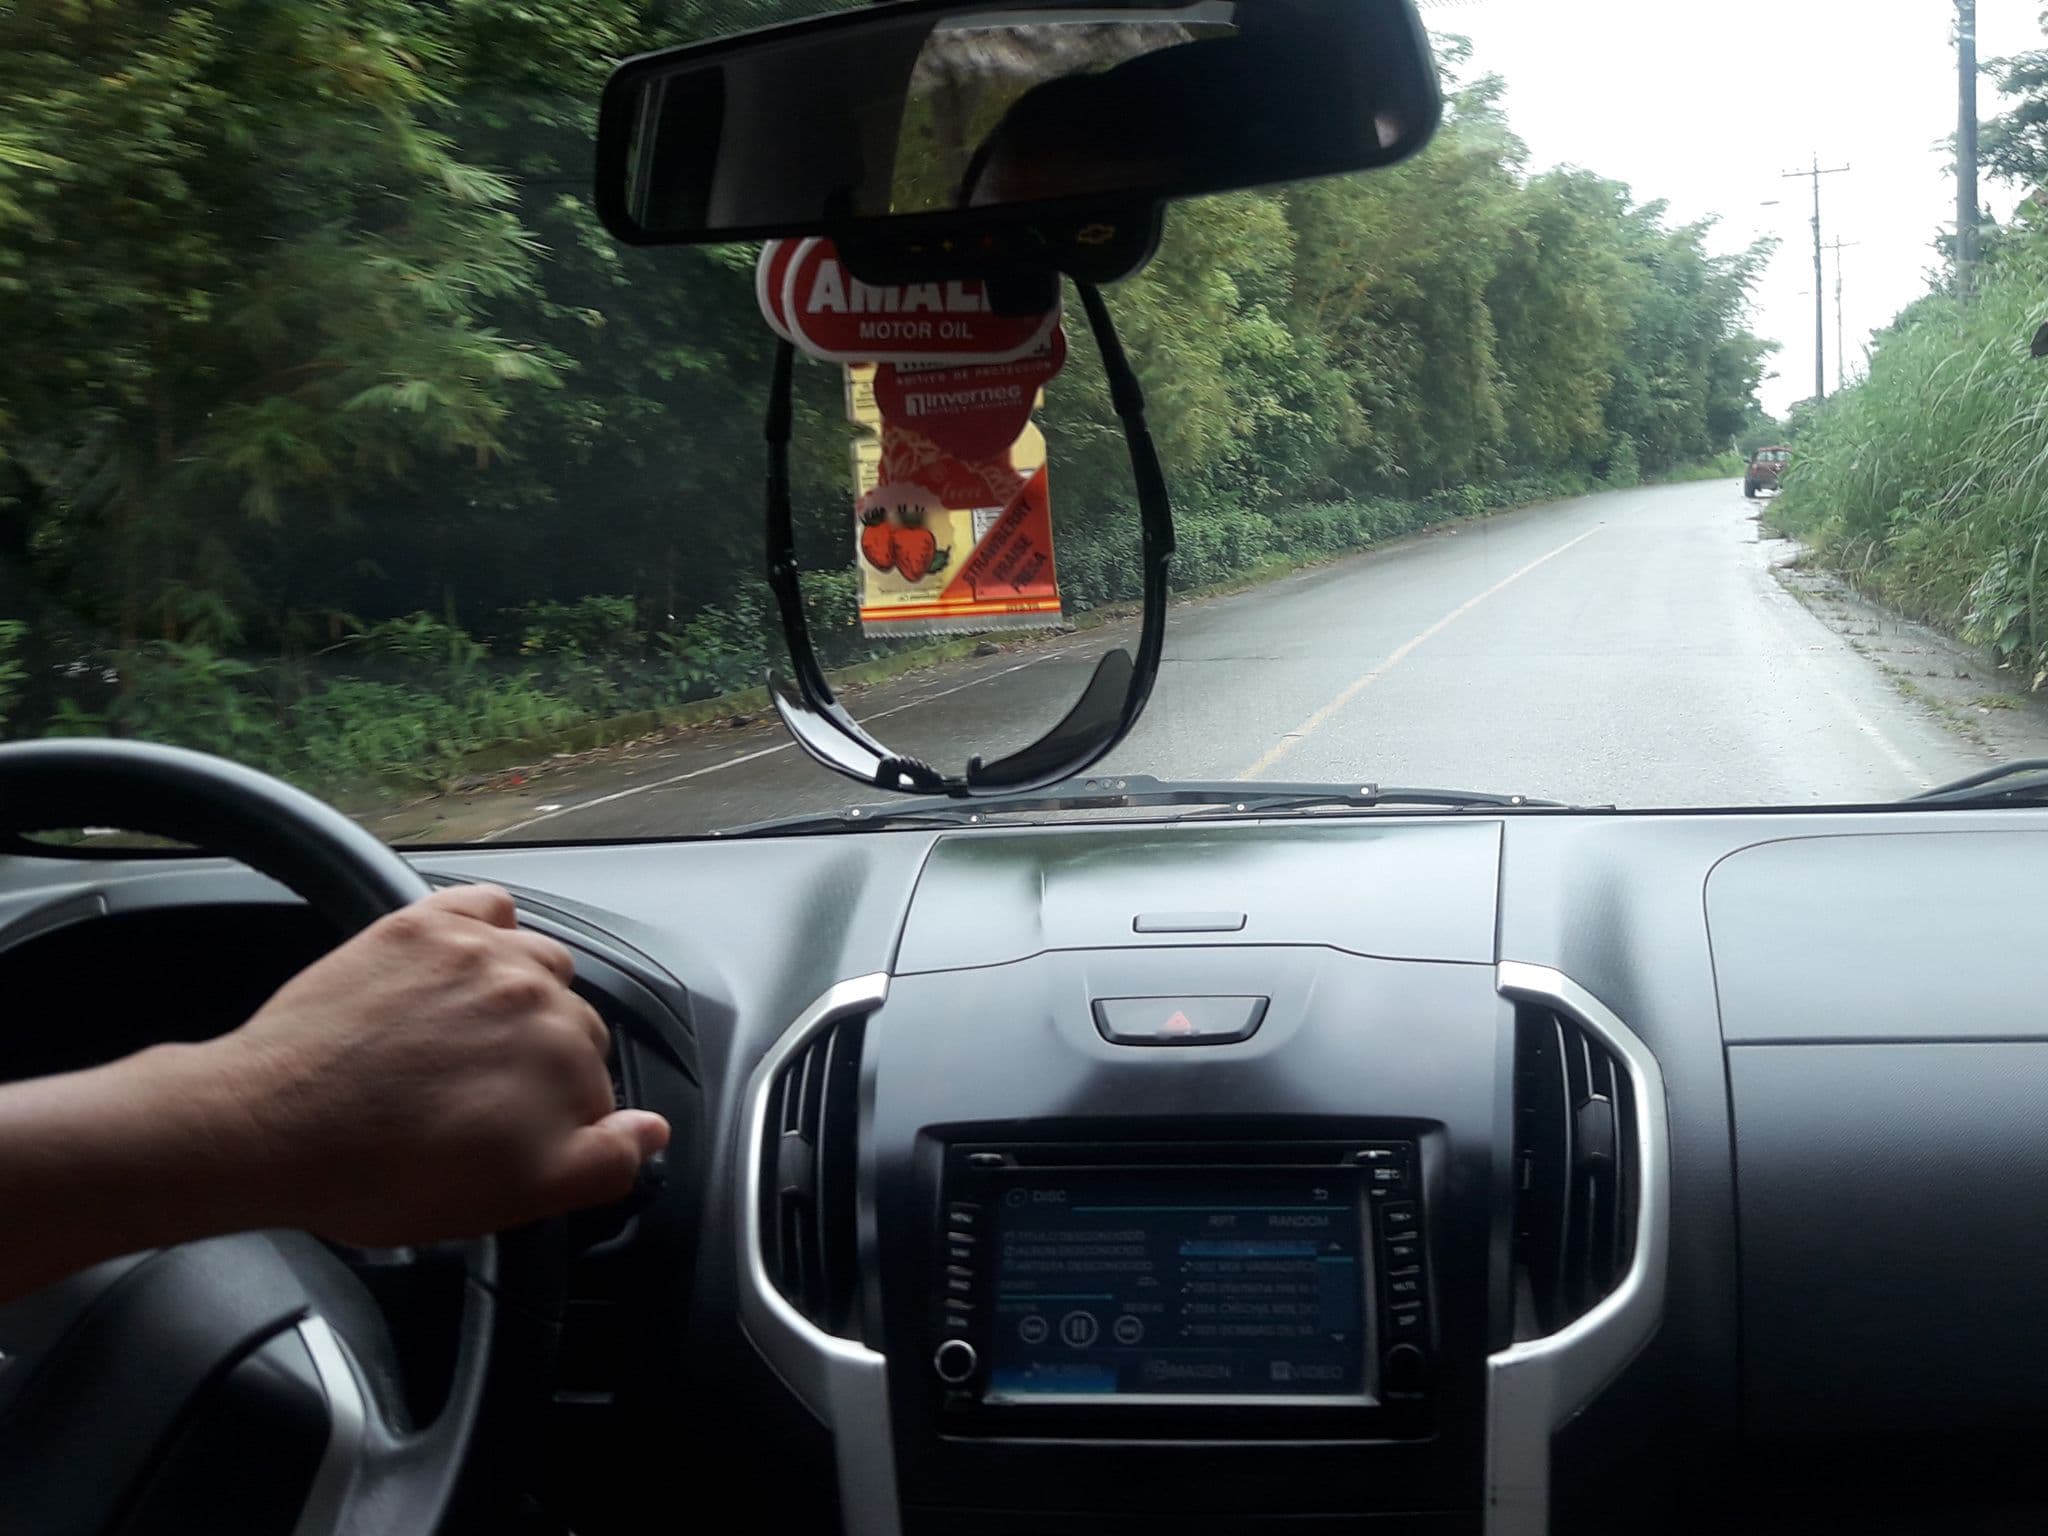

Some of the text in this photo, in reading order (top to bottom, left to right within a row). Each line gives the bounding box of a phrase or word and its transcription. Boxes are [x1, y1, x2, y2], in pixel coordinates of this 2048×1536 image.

[859, 321, 975, 340] MOTOR OIL
[1032, 1189, 1068, 1203] DISC
[1268, 1214, 1330, 1228] RANDOM
[1291, 1364, 1344, 1379] VIDEO
